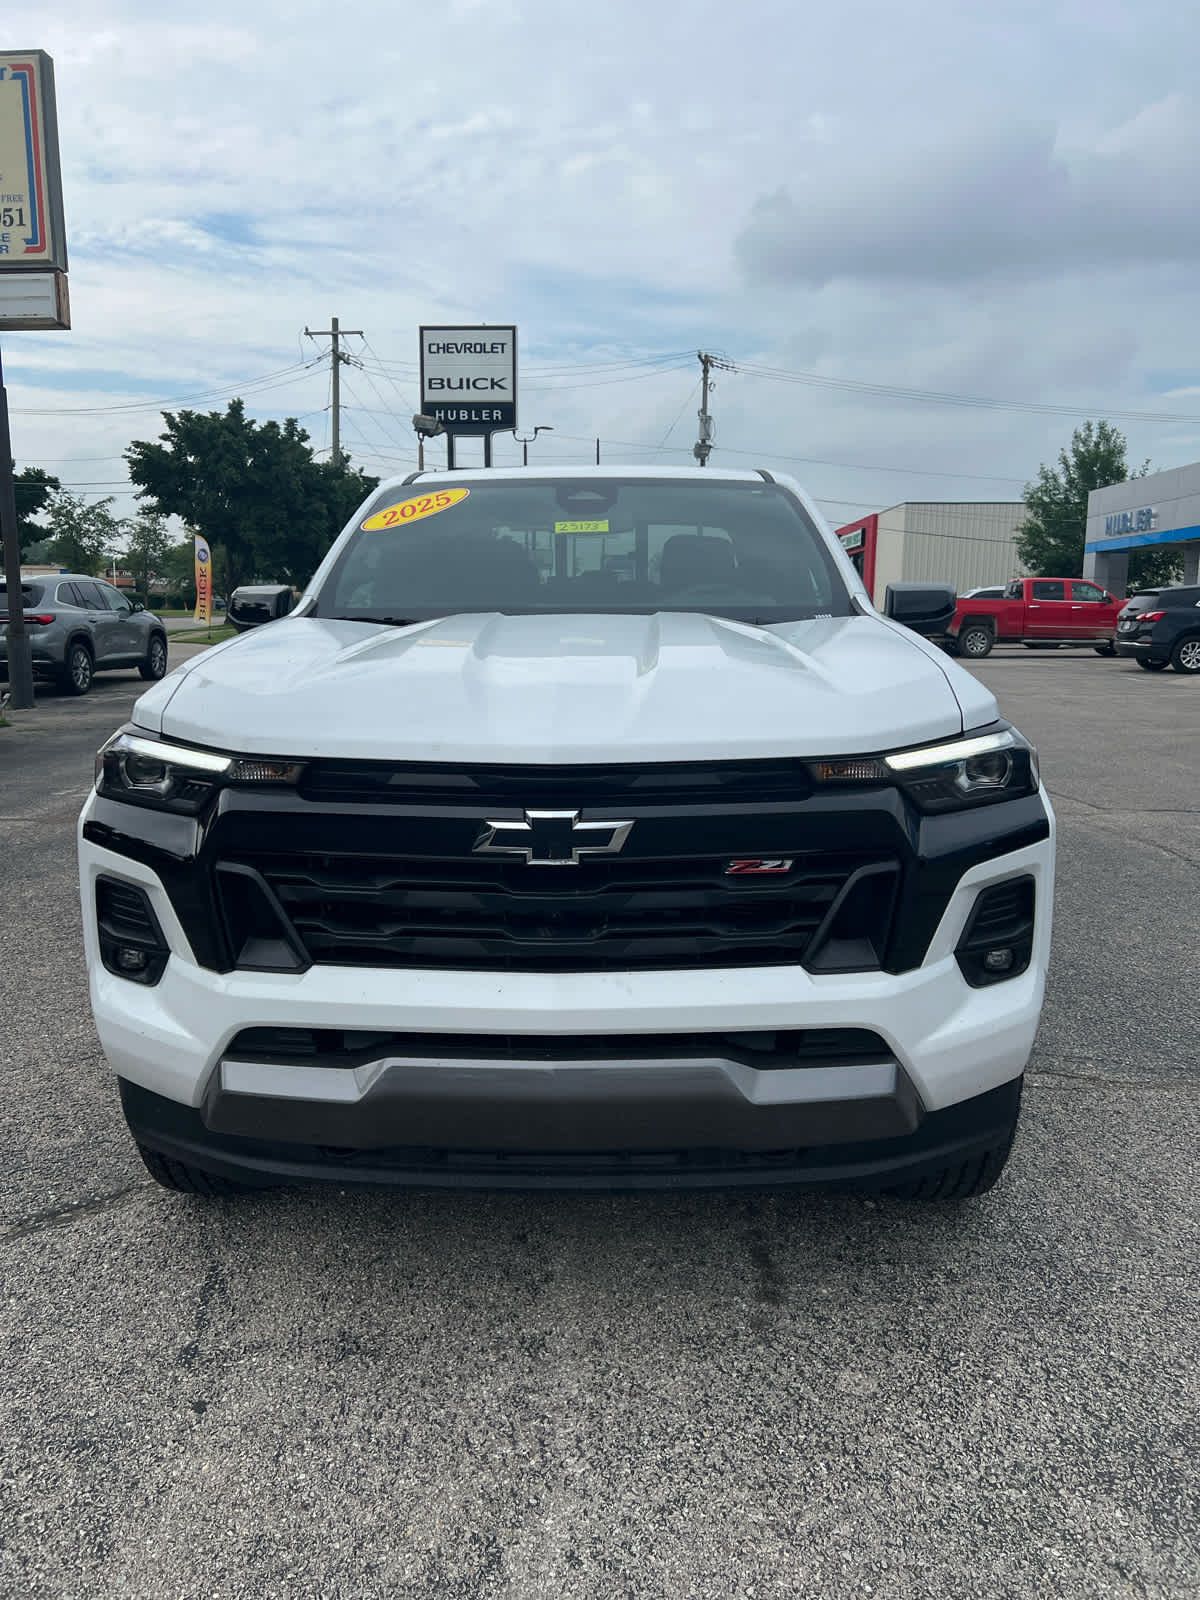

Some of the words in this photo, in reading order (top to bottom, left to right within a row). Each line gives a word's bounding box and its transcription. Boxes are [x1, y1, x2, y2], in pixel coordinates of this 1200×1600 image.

[0, 207, 26, 227] 51
[428, 342, 507, 354] CHEVROLET
[428, 377, 508, 390] BUICK
[435, 409, 503, 421] HUBLER
[383, 491, 451, 526] 2025
[1105, 508, 1154, 536] HUBLER
[199, 567, 207, 620] BUICK
[725, 859, 793, 873] Z71
